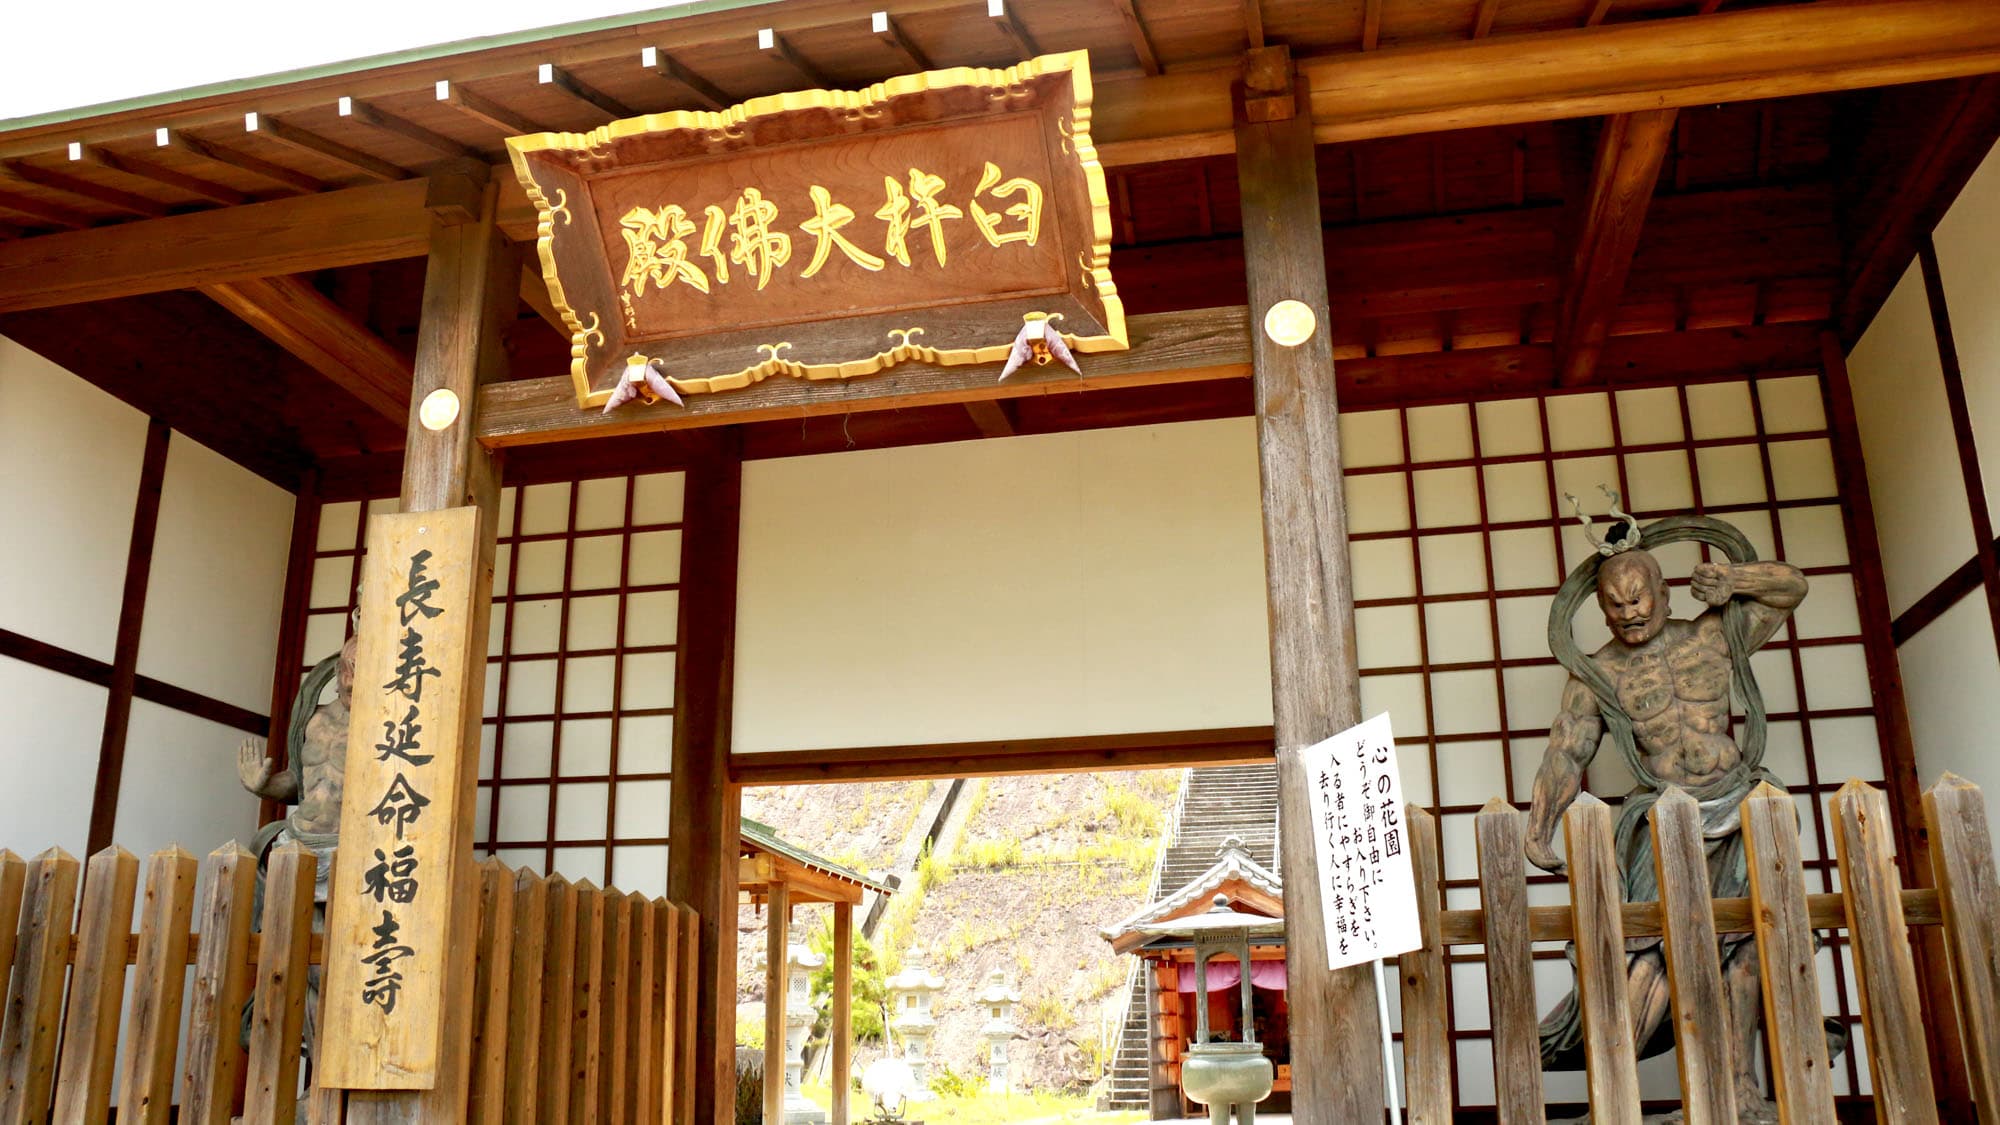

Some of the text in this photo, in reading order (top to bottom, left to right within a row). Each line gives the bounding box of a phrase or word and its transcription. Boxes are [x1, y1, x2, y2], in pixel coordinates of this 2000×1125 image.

[1318, 770, 1349, 956] 去り行く人に幸福を
[1356, 739, 1384, 886] どうぞ御自由に
[1371, 746, 1401, 858] 心の花園
